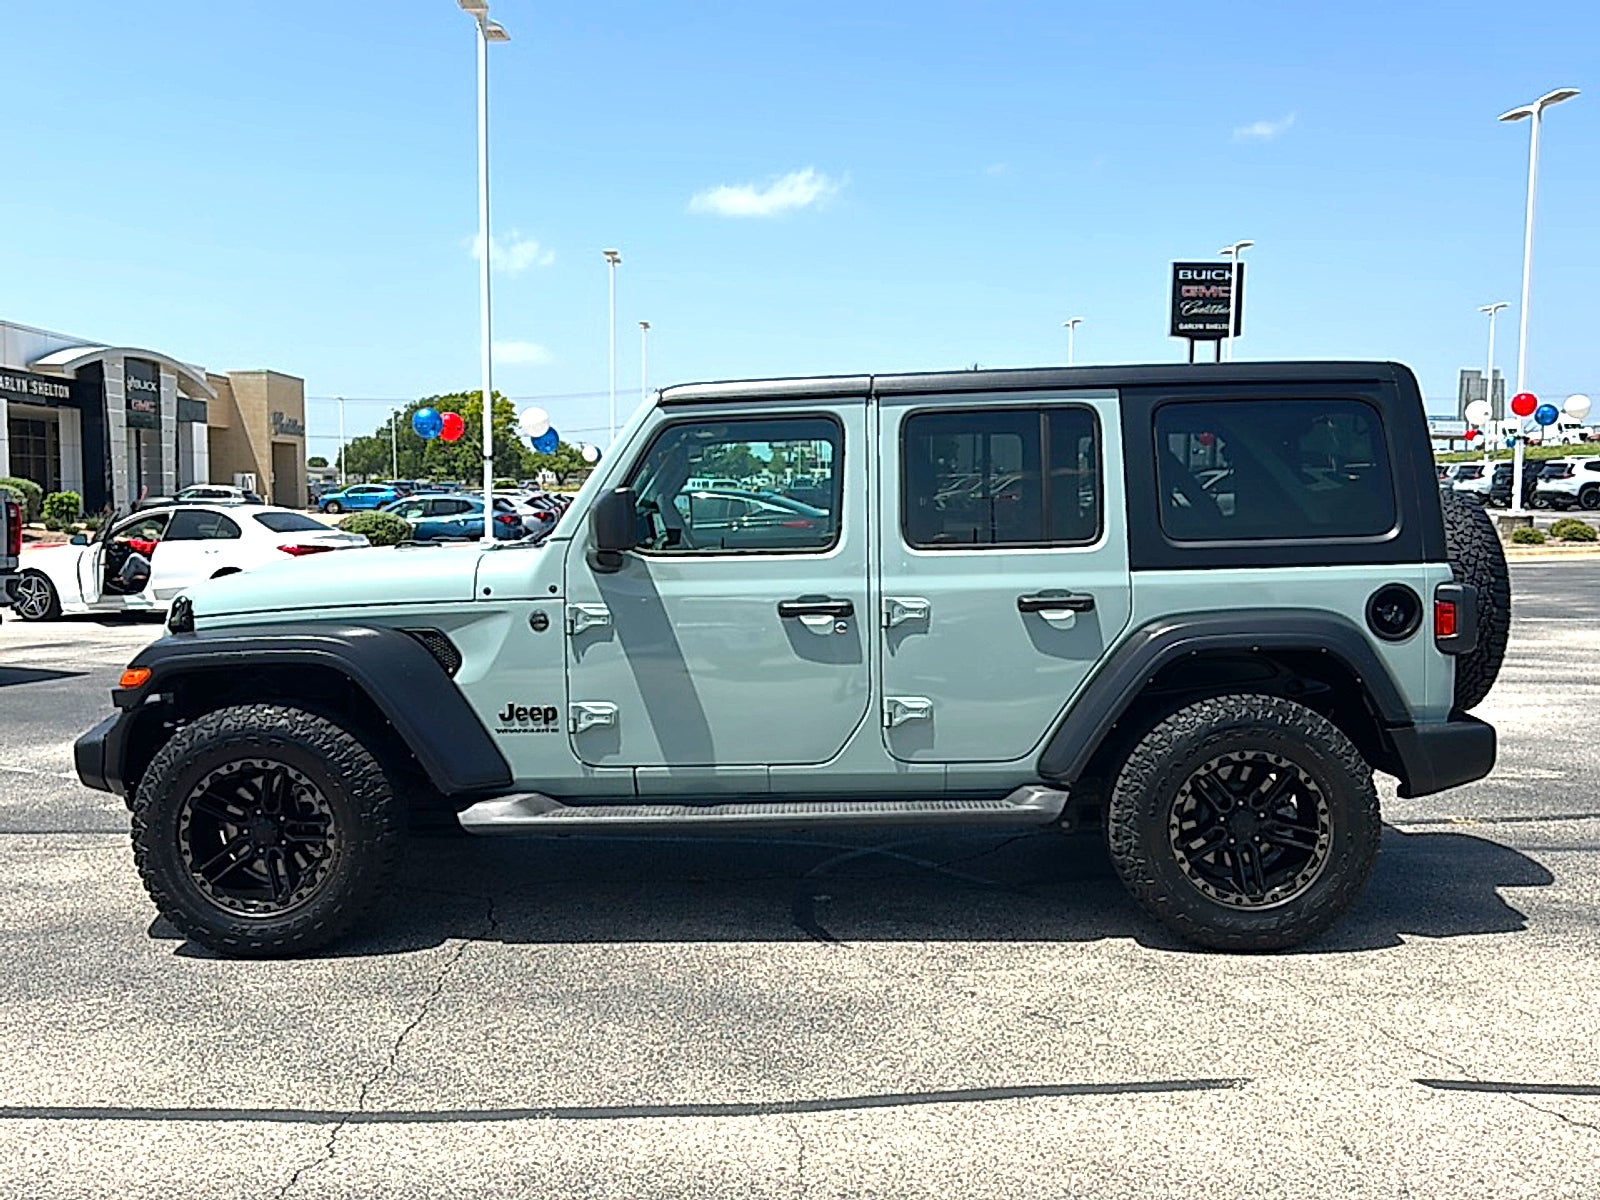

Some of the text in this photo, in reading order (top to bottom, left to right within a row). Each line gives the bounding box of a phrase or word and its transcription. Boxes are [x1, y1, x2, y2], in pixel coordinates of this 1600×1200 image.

[1178, 269, 1233, 280] BUICK
[1181, 285, 1231, 297] GMC
[29, 380, 70, 399] SHELTON
[131, 399, 157, 413] GMC
[498, 703, 558, 725] Jeep
